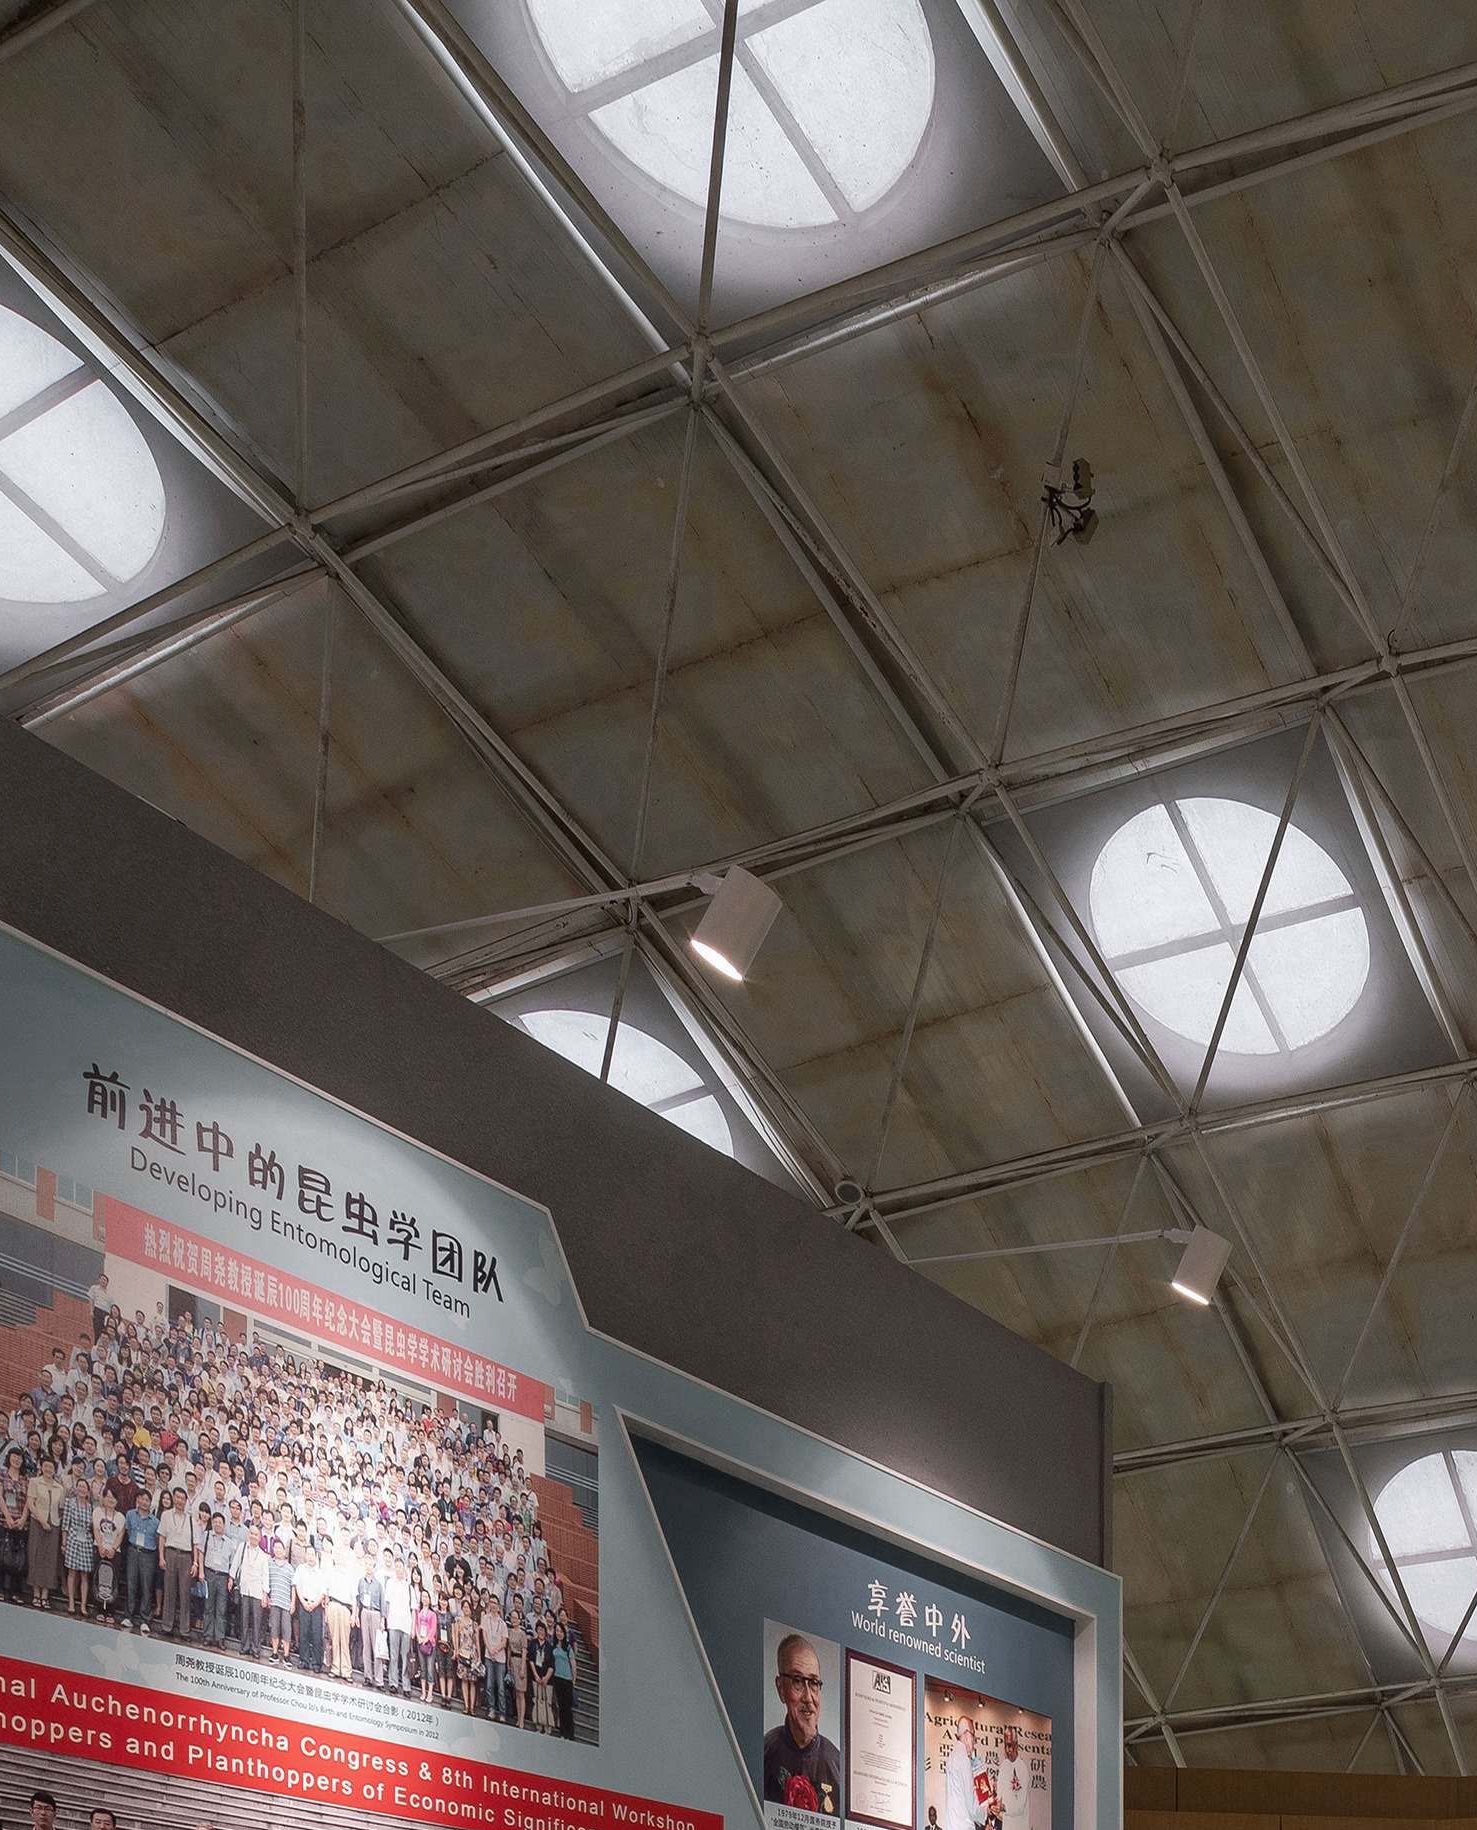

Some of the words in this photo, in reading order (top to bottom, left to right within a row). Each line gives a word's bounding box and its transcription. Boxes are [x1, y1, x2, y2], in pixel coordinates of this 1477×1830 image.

[83, 1062, 505, 1303] 前进中的昆虫学团队
[131, 1146, 261, 1230] Developing
[272, 1210, 415, 1294] Entomological
[423, 1279, 469, 1318] Team
[852, 1611, 885, 1637] World
[889, 1624, 941, 1657] renowned
[944, 1645, 985, 1674] scientist
[867, 1579, 971, 1649] 享誉中外
[50, 1683, 290, 1753] Auchenorrhyncha
[300, 1736, 410, 1777] Congress
[418, 1761, 433, 1781] &
[441, 1766, 474, 1790] 8th
[483, 1776, 607, 1817] International
[125, 1738, 176, 1762] and
[187, 1745, 354, 1796] Planthoppers
[362, 1780, 386, 1801] of
[394, 1787, 496, 1824] Economic
